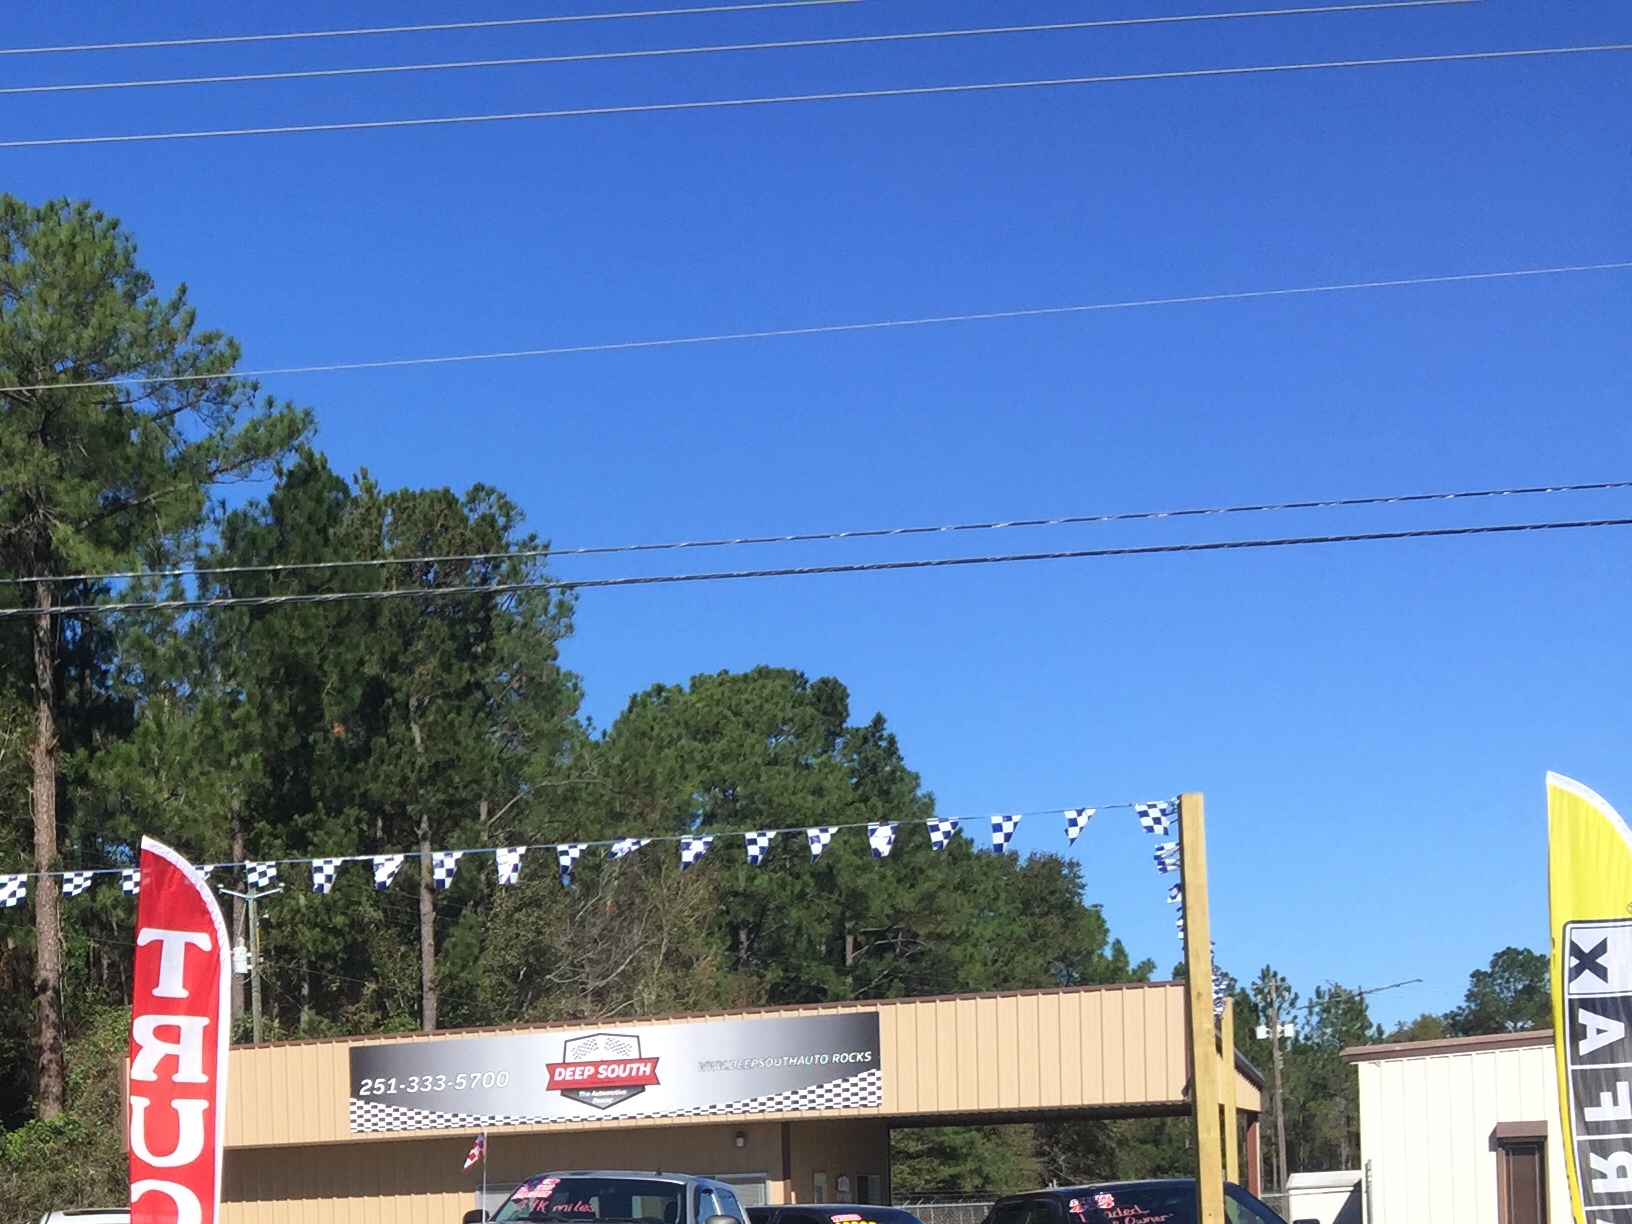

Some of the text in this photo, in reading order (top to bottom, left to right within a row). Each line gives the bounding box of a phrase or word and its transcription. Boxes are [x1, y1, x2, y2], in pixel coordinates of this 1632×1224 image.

[553, 1063, 652, 1081] DEEP SOUTH
[359, 1070, 510, 1096] 251-333-5700
[552, 1200, 594, 1213] miles
